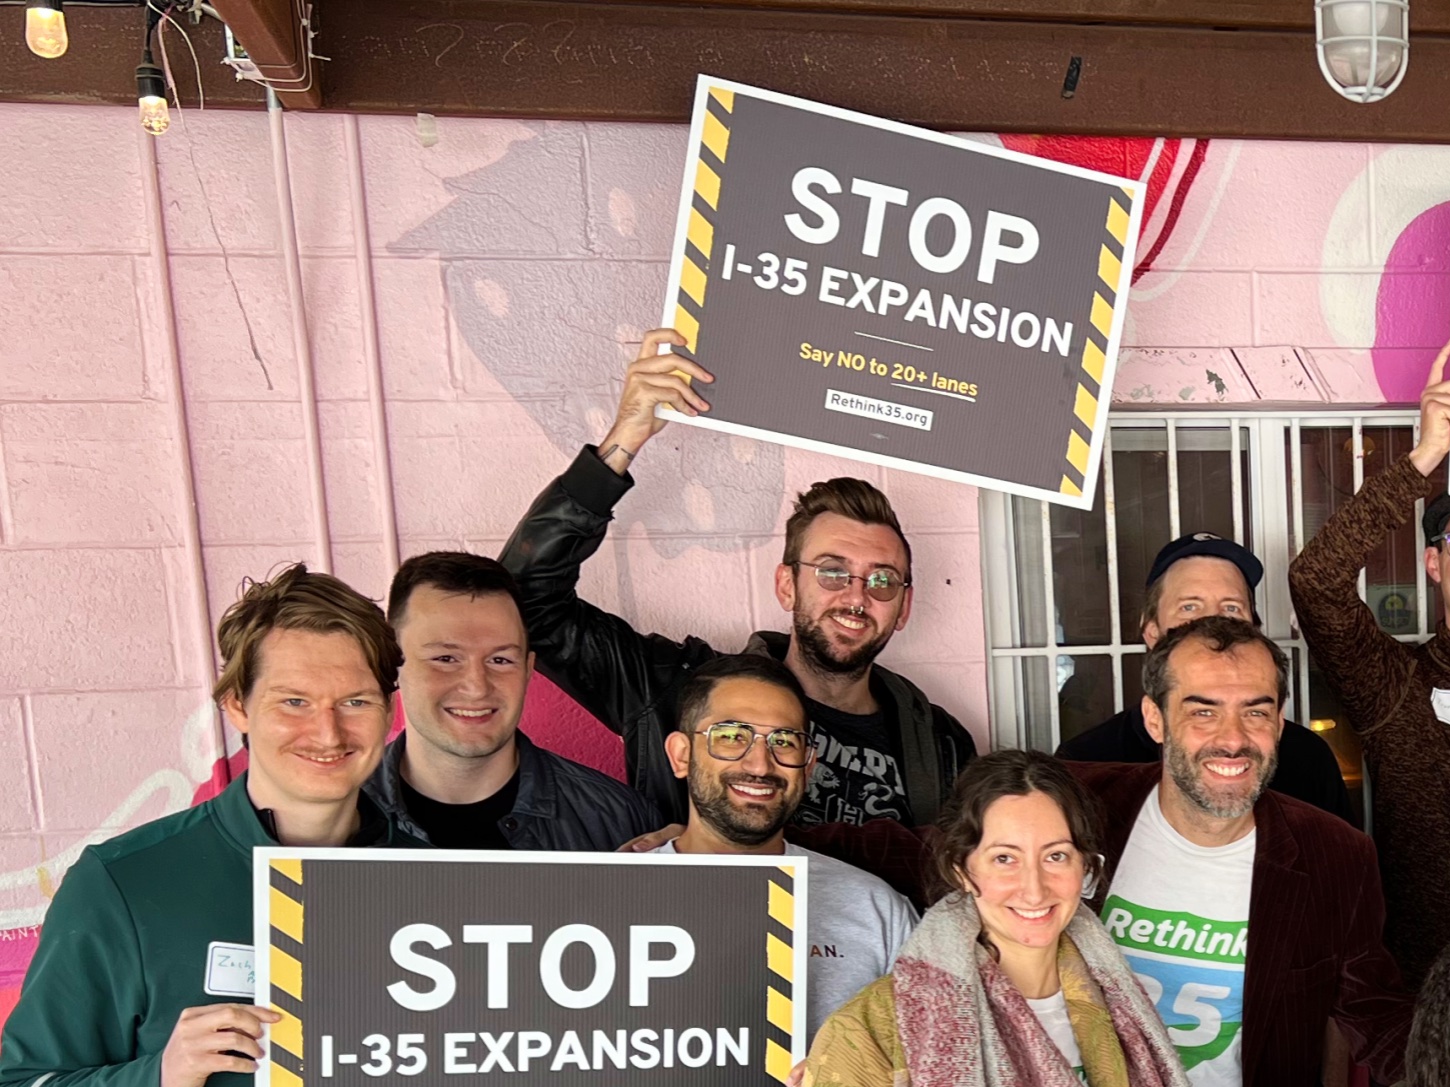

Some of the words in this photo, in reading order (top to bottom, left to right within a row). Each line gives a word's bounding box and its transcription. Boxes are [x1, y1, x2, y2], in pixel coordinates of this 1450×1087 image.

[783, 166, 1040, 285] STOP
[721, 243, 808, 296] I-35
[818, 265, 1073, 357] EXPANSION
[799, 342, 834, 368] Say
[837, 353, 866, 371] NO
[869, 358, 888, 377] to
[891, 363, 928, 384] 20+
[932, 371, 979, 397] lanes
[830, 393, 929, 428] Rethink35.org
[1104, 907, 1248, 957] Rethink
[386, 923, 696, 1012] STOP
[1137, 971, 1232, 1048] 5
[320, 1033, 428, 1078] I-35
[444, 1027, 750, 1075] EXPANSION
